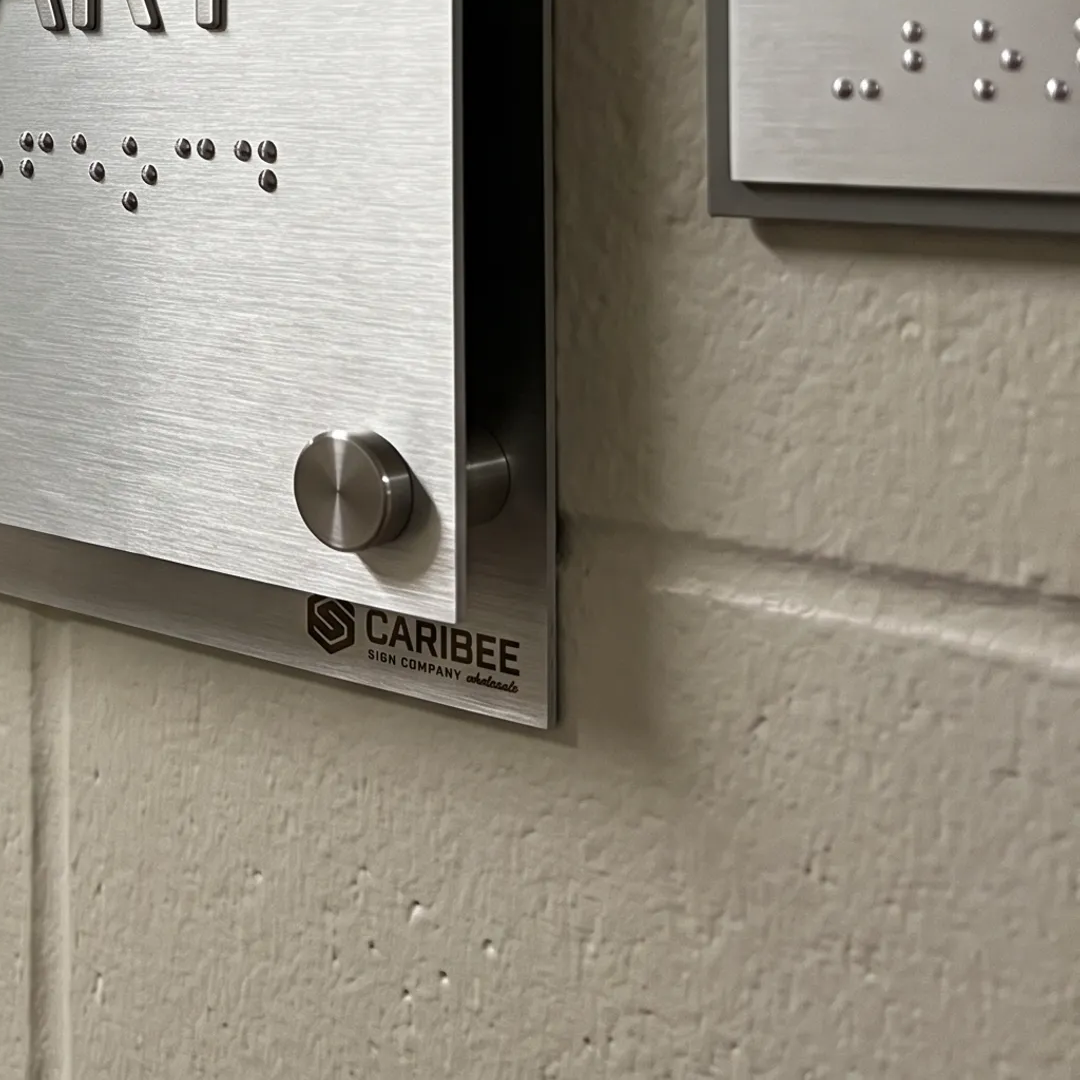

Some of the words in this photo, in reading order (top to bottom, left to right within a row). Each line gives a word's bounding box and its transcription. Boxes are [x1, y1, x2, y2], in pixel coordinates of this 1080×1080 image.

[366, 609, 520, 677] CARIBEE
[368, 649, 396, 666] SIGN
[401, 657, 462, 680] COMPANY
